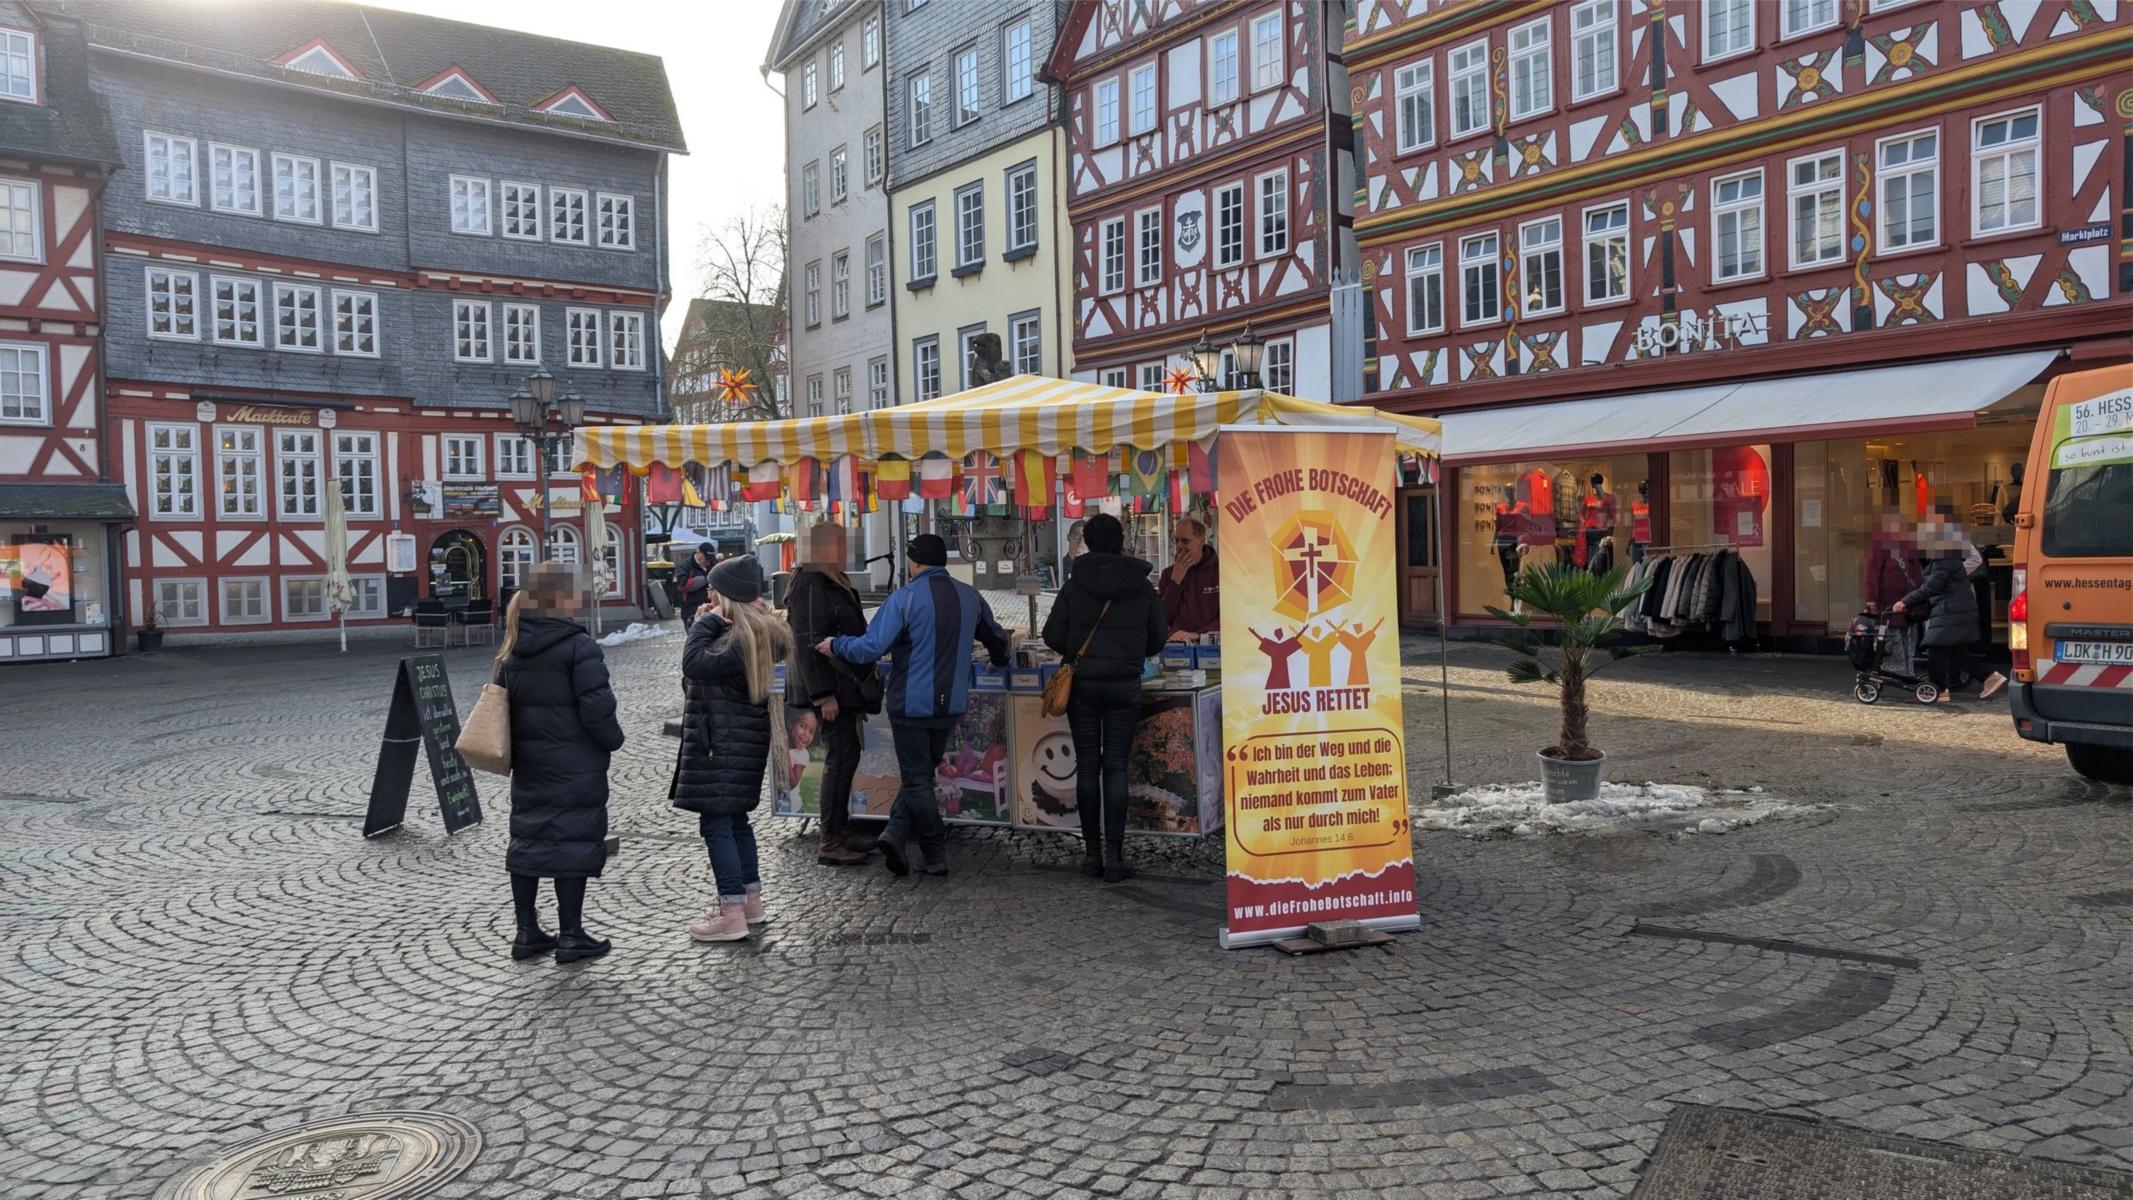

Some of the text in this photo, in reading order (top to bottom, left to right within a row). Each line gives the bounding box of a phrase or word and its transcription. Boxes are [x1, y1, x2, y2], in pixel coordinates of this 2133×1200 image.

[2061, 228, 2109, 243] Marktplatz
[2076, 405, 2094, 420] 56.
[80, 444, 86, 452] 8
[2064, 453, 2077, 462] so
[2111, 441, 2125, 454] ist
[1225, 468, 1393, 524] DIE FROHE BOTSCHAFT
[2070, 628, 2130, 637] MASTER
[2064, 643, 2092, 658] LDK
[2102, 644, 2112, 659] H
[416, 663, 441, 682] JESUS
[419, 685, 448, 699] CHRISTUS
[1262, 687, 1370, 715] JESUS RETTET
[1253, 737, 1391, 762] Ich bin der Weg und die
[1247, 762, 1393, 786] Wahrheit und das Leben;
[1240, 784, 1399, 810] niemand kommt zum Vater
[1263, 808, 1380, 833] als nur durch mich!
[1291, 834, 1333, 846] Johannes
[1234, 889, 1413, 919] www.dieFroheBotschaft.info
